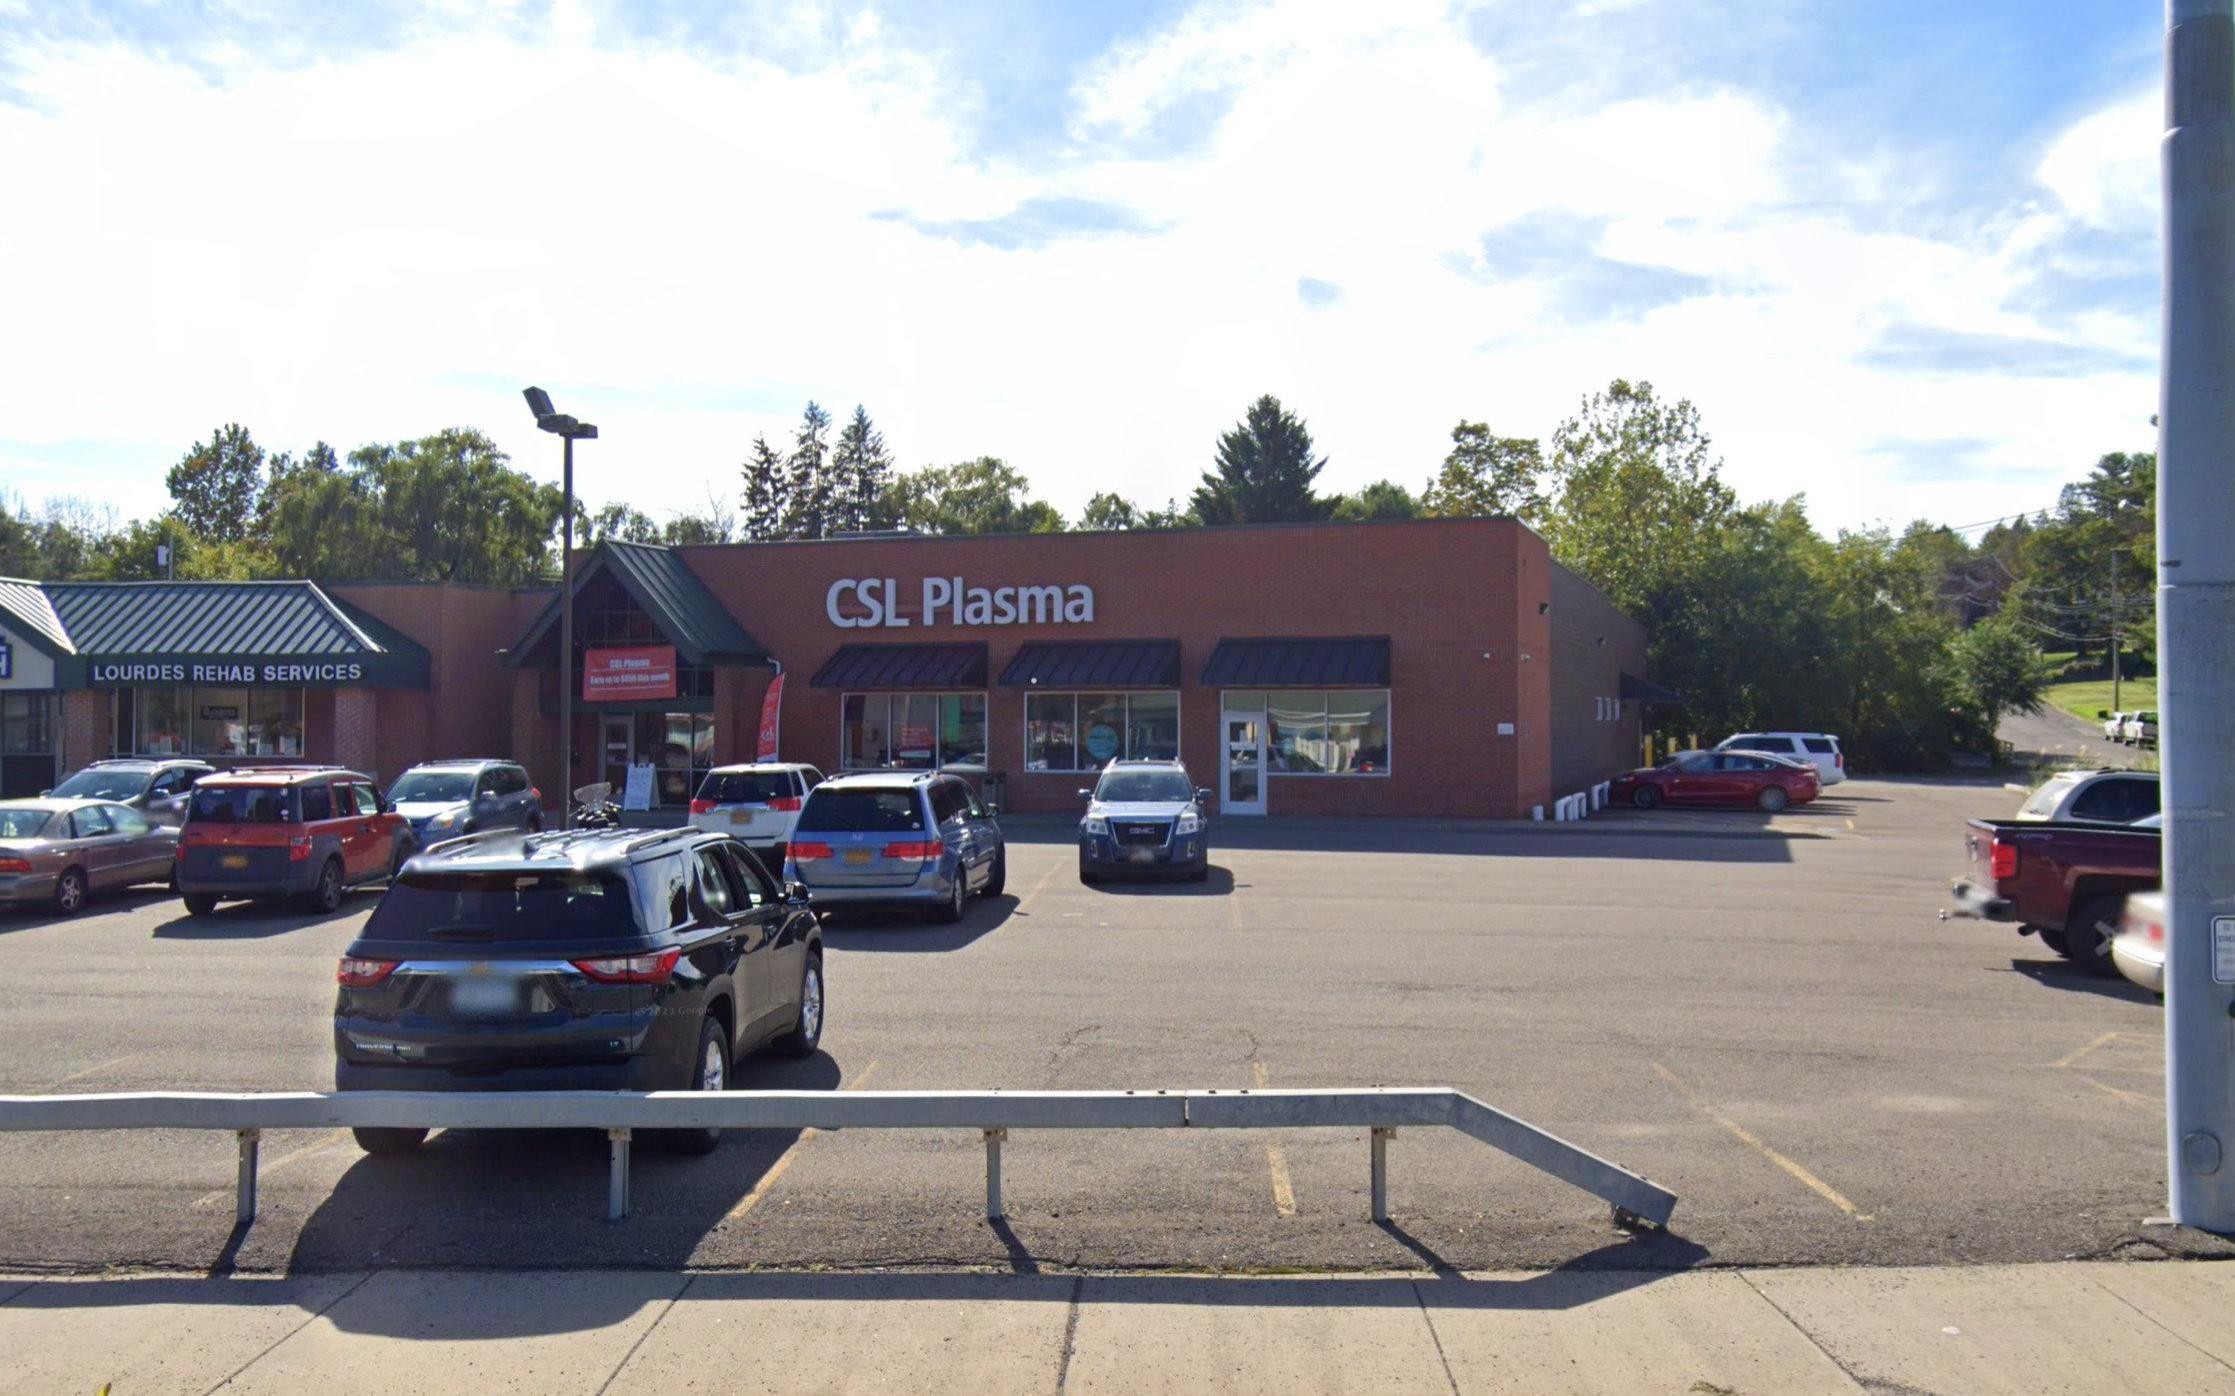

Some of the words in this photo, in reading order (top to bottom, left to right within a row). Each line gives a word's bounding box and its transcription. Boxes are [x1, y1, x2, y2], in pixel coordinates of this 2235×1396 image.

[825, 577, 910, 628] CSL
[922, 576, 1095, 626] Plasma
[94, 664, 185, 681] LOURDES
[193, 665, 256, 682] REHAB
[264, 663, 361, 681] SERVICES
